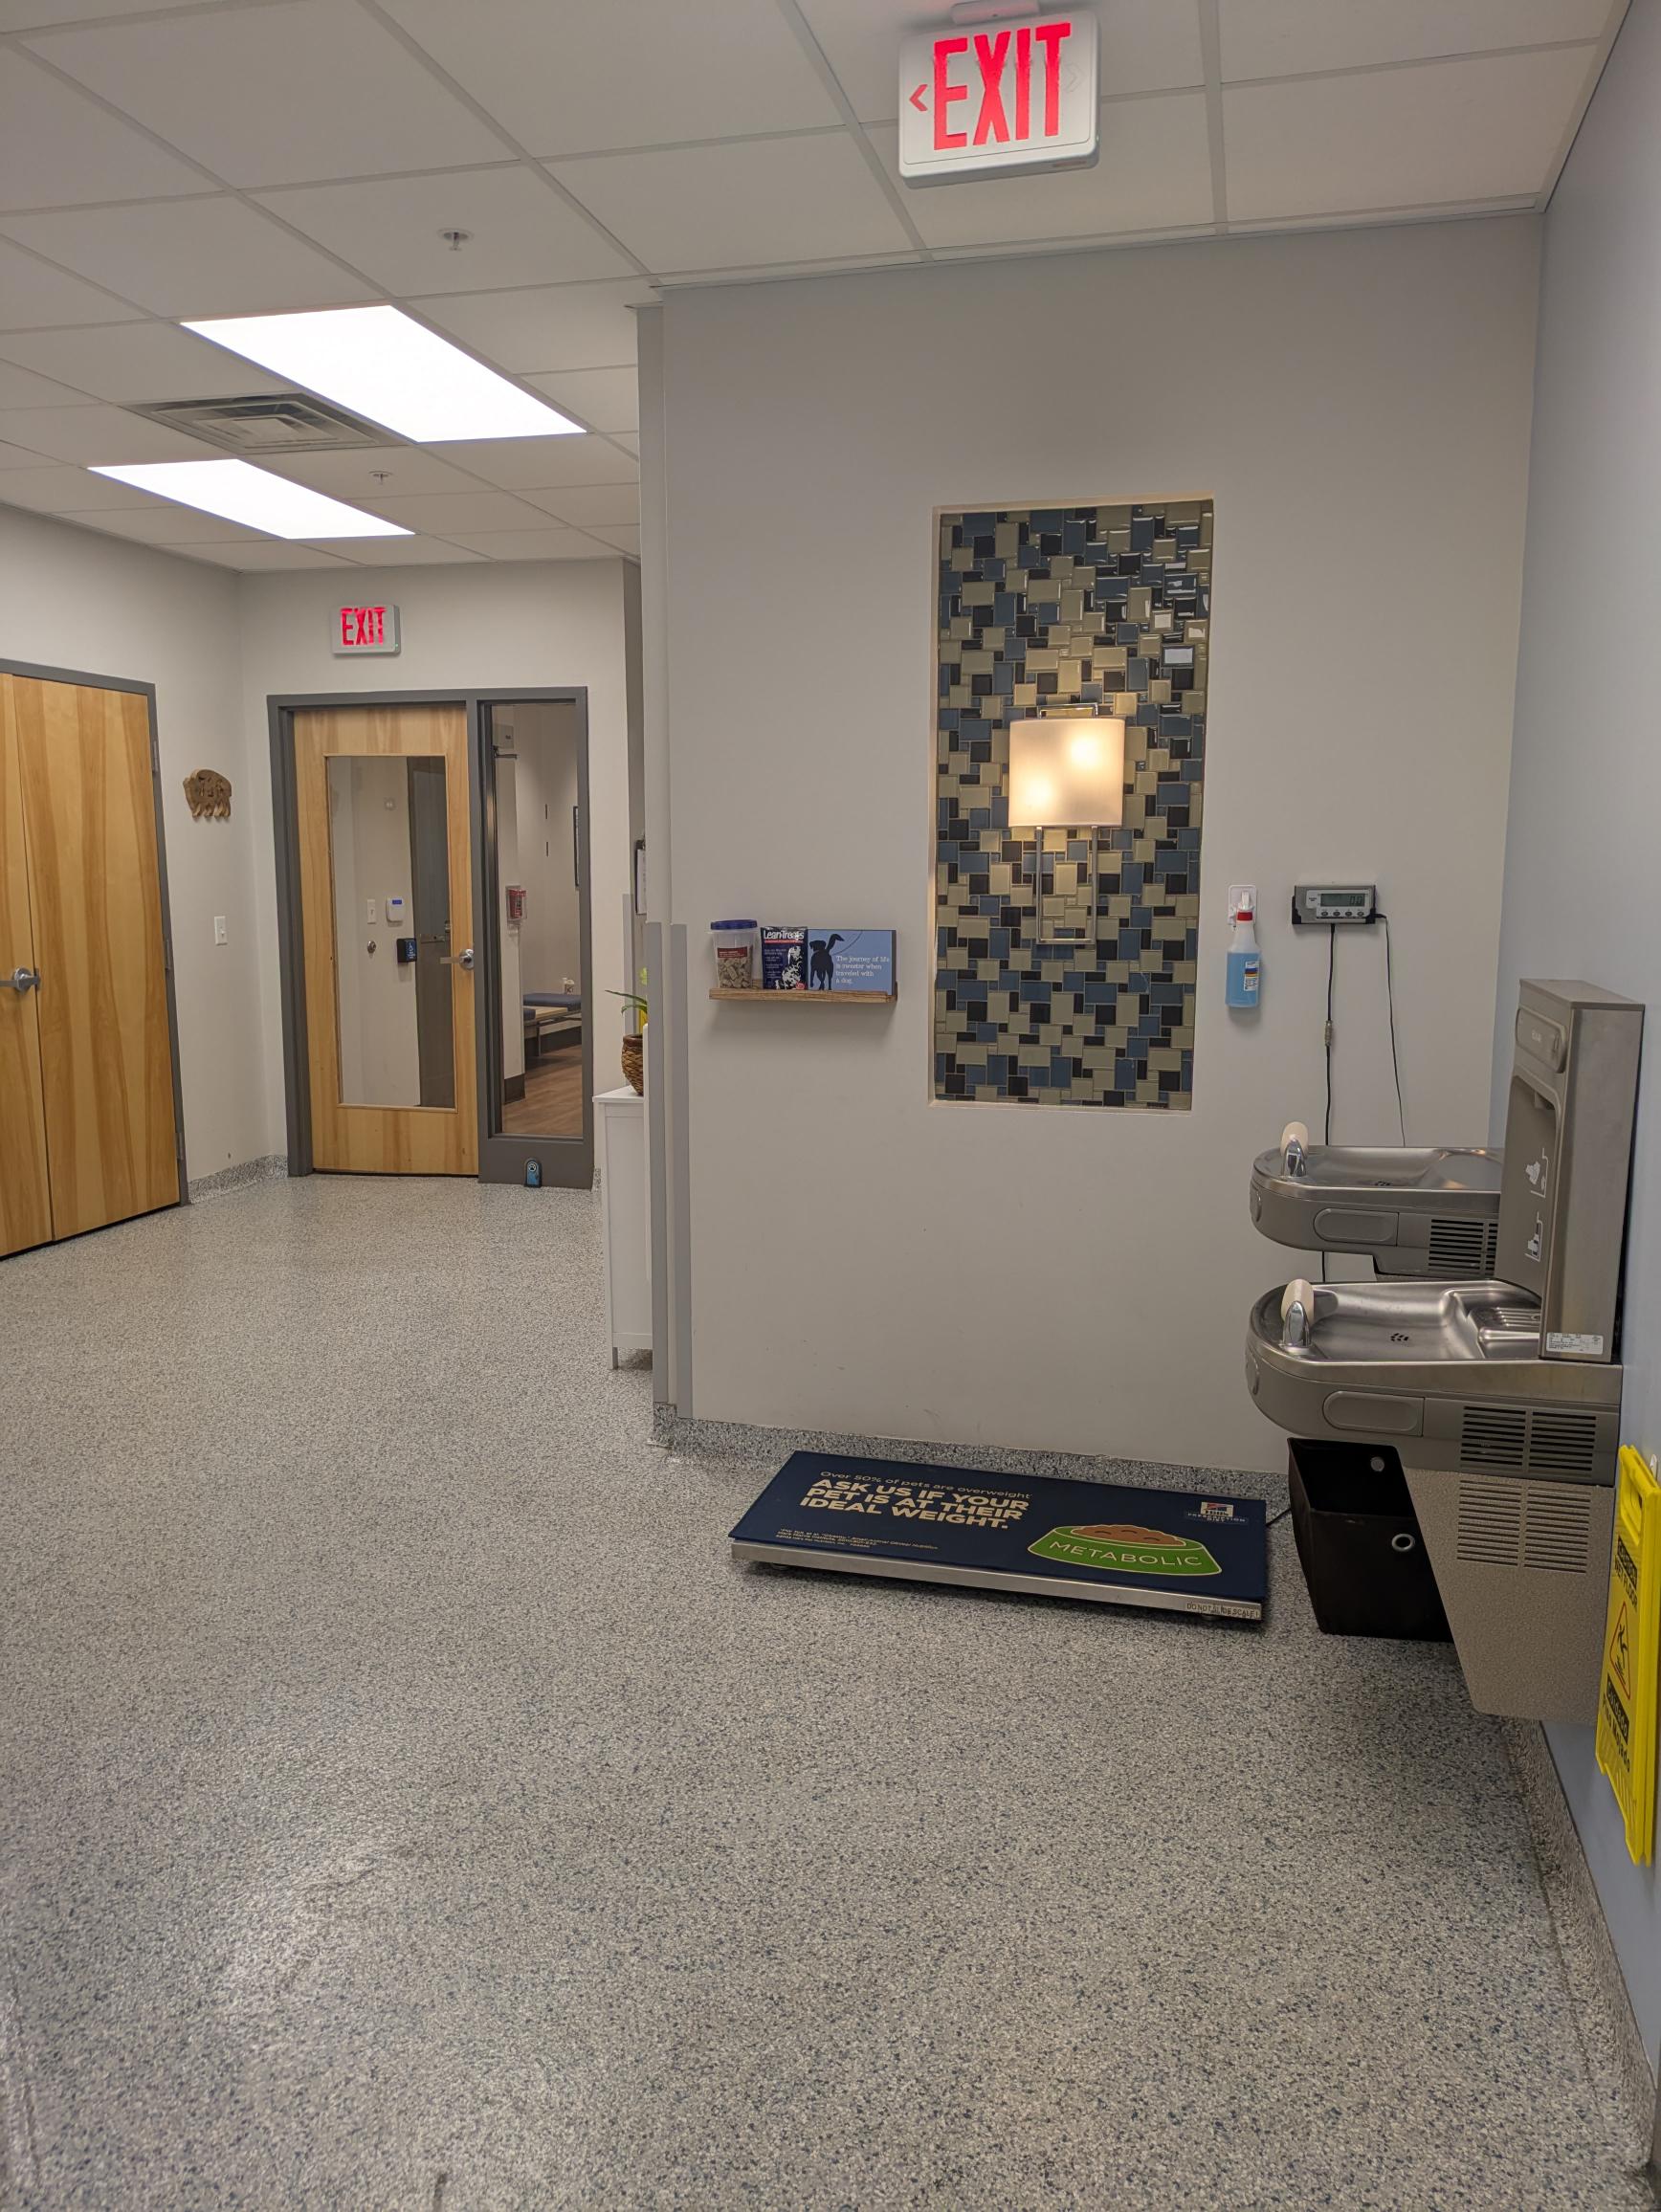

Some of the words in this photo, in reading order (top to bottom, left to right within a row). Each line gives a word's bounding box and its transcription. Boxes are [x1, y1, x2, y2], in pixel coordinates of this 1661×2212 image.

[934, 22, 1071, 150] EXIT
[341, 607, 387, 645] EXIT
[811, 1478, 872, 1493] ASK
[875, 1485, 913, 1496] US
[919, 1490, 945, 1499] IF
[951, 1493, 1030, 1511] YOUR
[853, 1474, 881, 1483] 50%
[800, 1496, 882, 1515] IDEAL
[891, 1506, 1008, 1529] WEIGHT.
[807, 1487, 861, 1501] PET
[864, 1493, 891, 1504] IS
[895, 1497, 935, 1509] AT
[940, 1502, 1023, 1520] THEIR
[1049, 1540, 1203, 1566] METABOLIC
[1198, 1604, 1211, 1613] NOT
